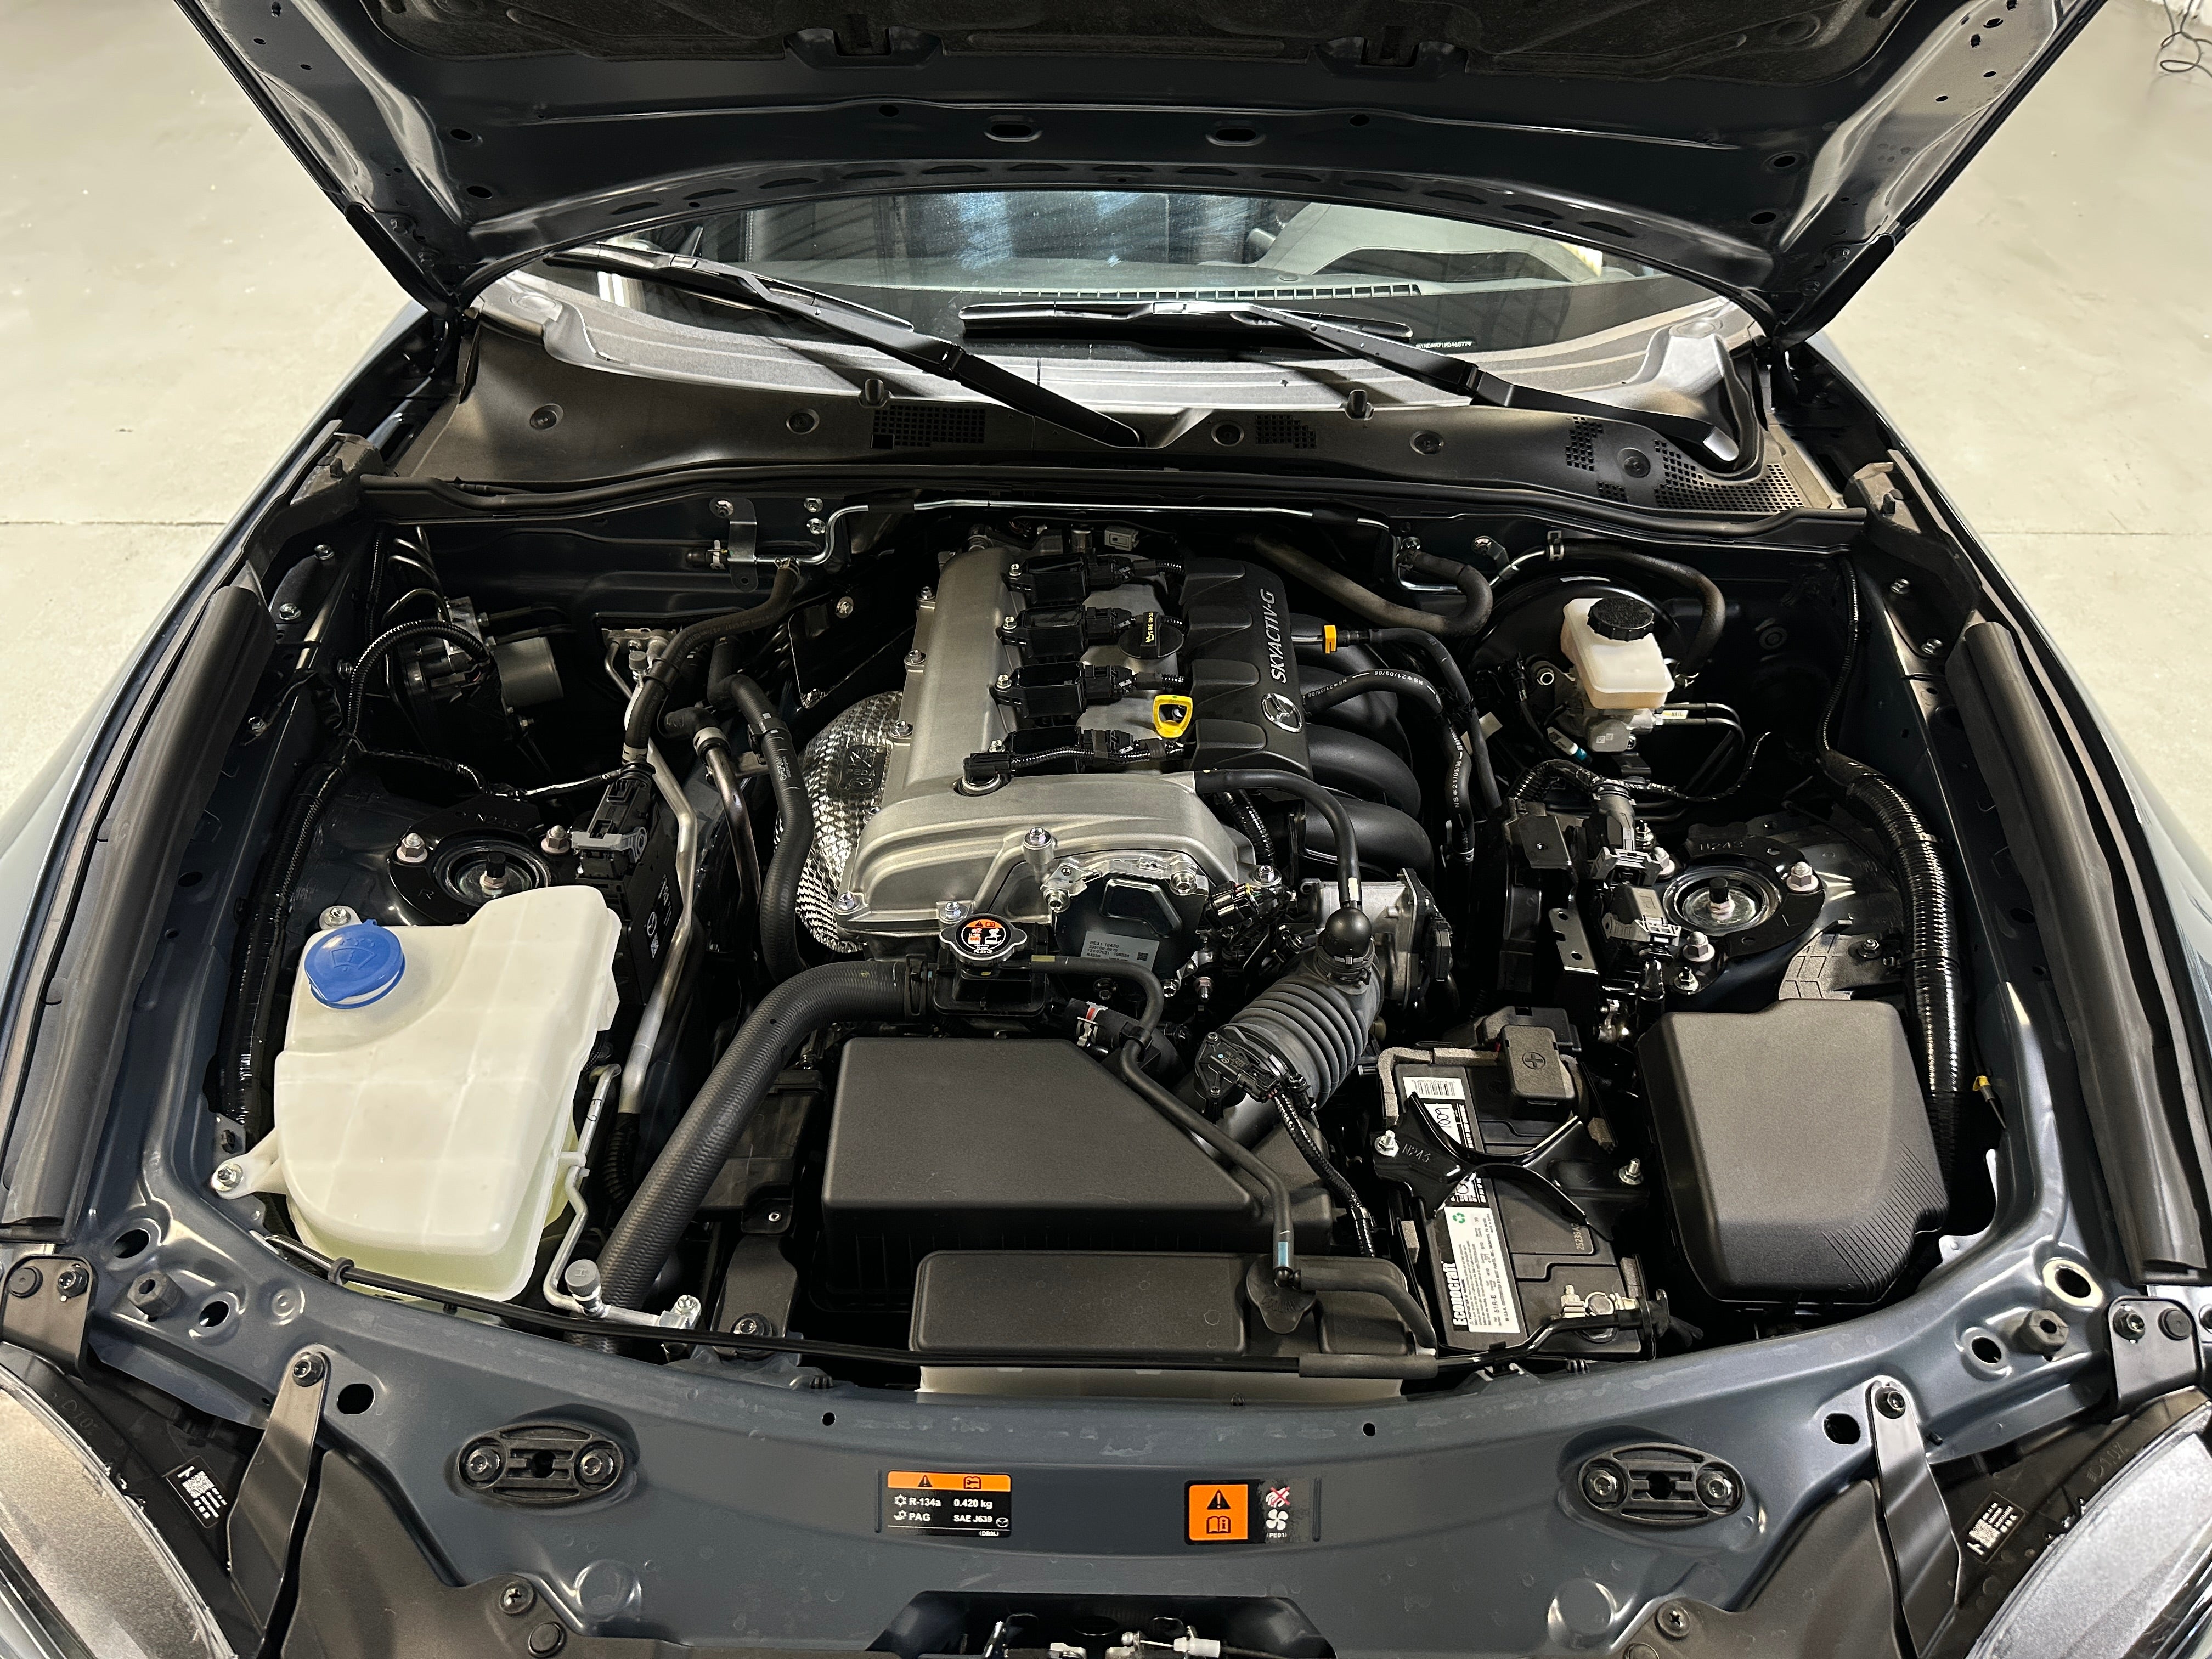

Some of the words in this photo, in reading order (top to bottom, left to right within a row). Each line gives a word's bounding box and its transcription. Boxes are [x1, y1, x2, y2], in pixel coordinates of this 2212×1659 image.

[1260, 589, 1286, 684] SKYACTIV-G
[1442, 1262, 1468, 1326] Econocraft
[909, 1498, 941, 1506] R-134a
[953, 1499, 979, 1508] 0.420
[980, 1499, 993, 1509] kg
[909, 1513, 930, 1521] PAG
[953, 1514, 972, 1522] SAE
